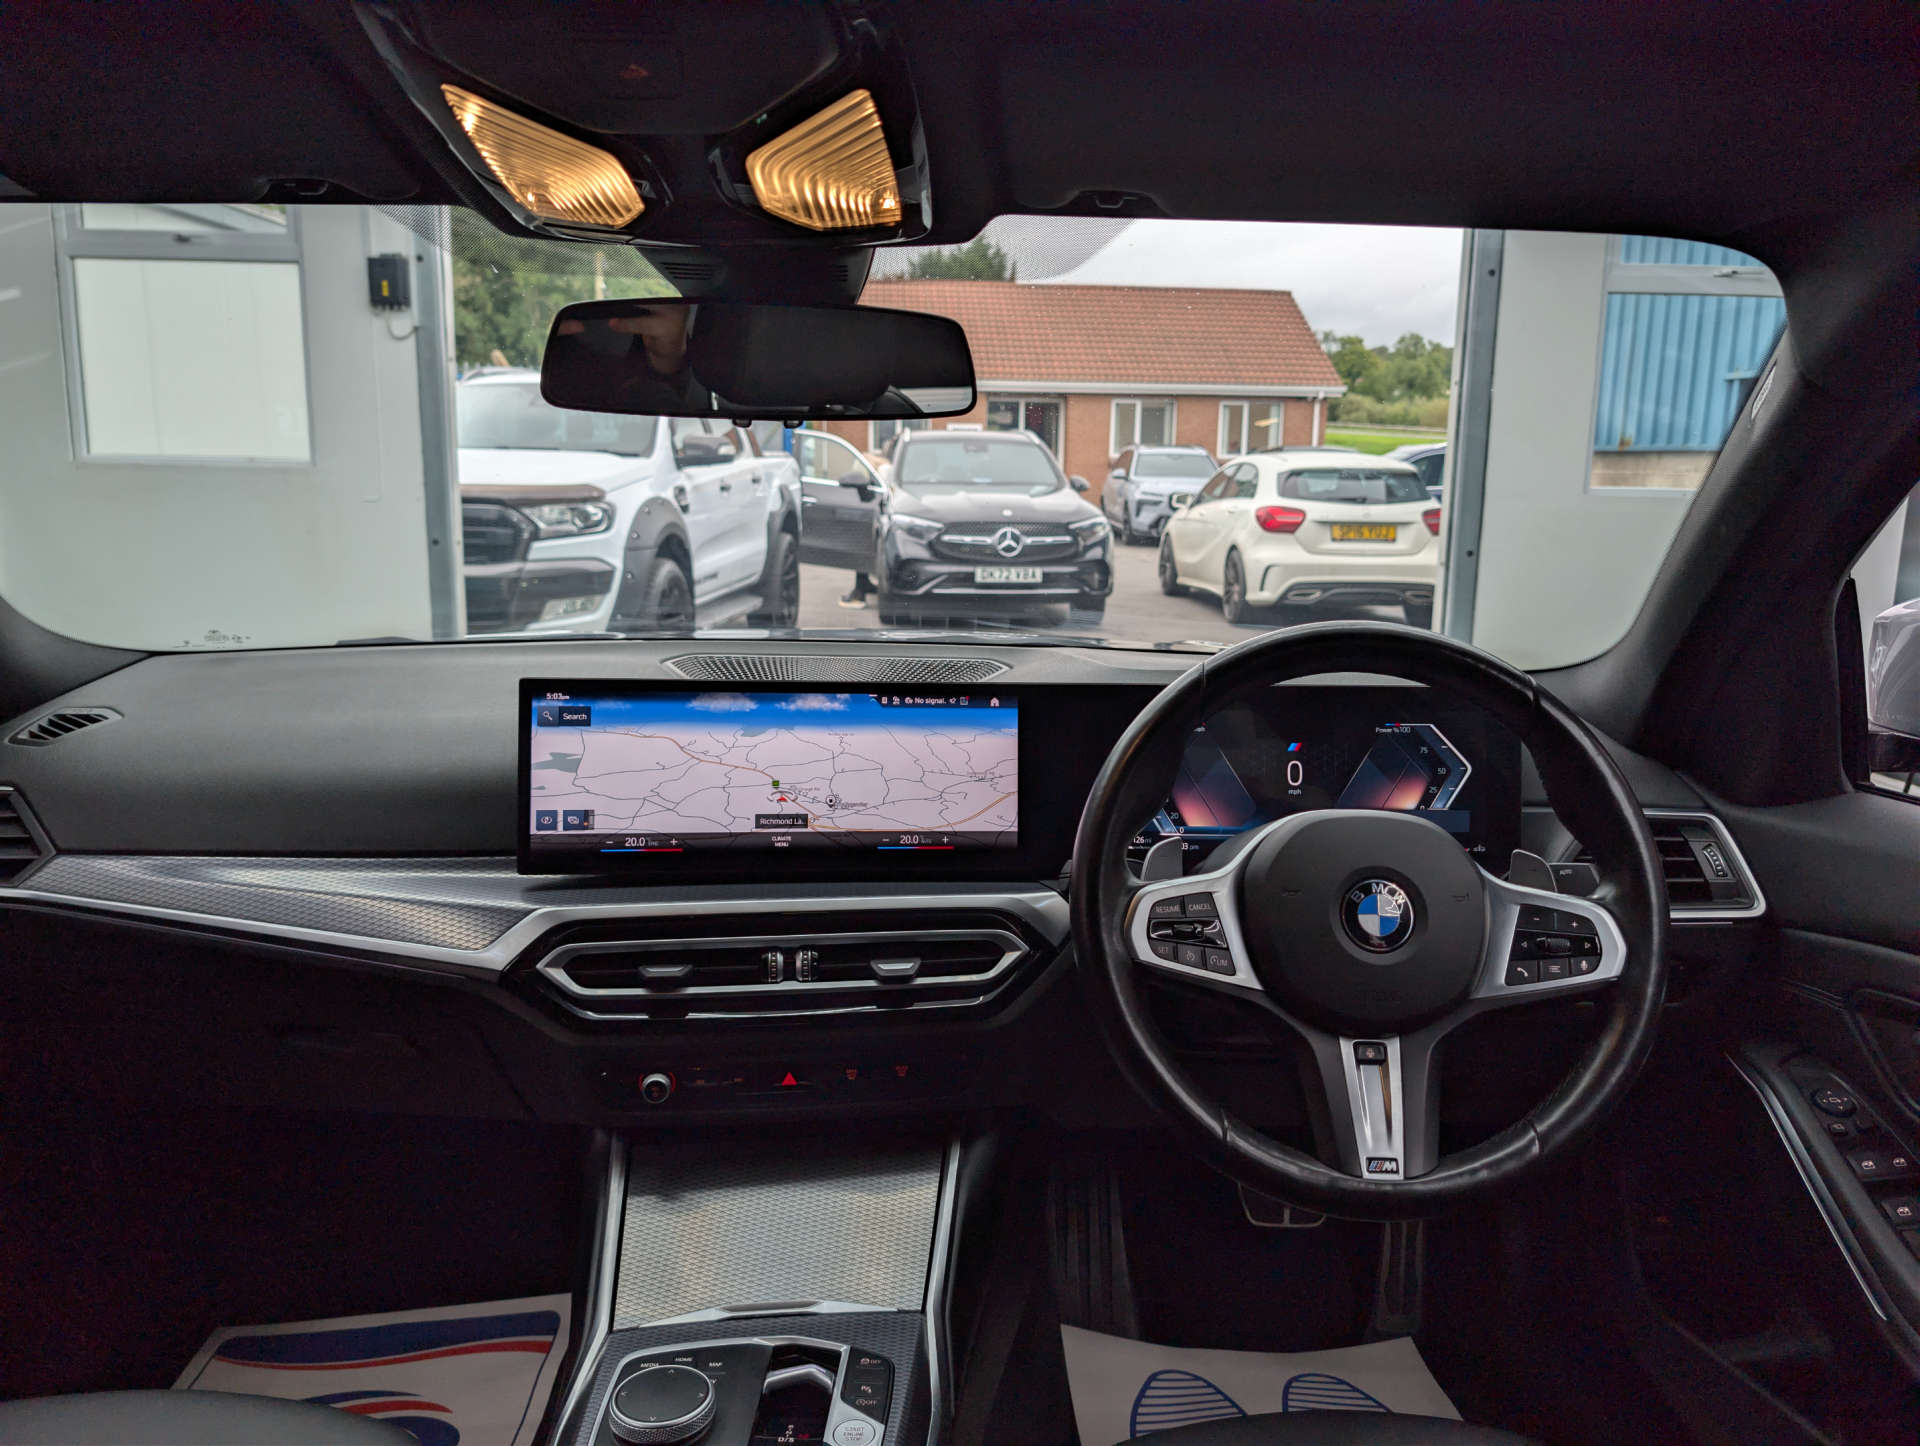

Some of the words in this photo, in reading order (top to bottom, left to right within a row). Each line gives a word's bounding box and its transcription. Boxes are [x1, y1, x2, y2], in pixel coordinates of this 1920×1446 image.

[562, 712, 588, 721] Search
[1287, 760, 1303, 786] 0
[1438, 767, 1447, 775] 50
[1287, 788, 1302, 797] mph
[1170, 812, 1180, 820] 20
[625, 837, 646, 847] 20.0
[900, 835, 919, 844] 20.0
[1155, 904, 1180, 913] RESUME
[1188, 903, 1212, 911] CANCEL
[1159, 946, 1169, 954] SET
